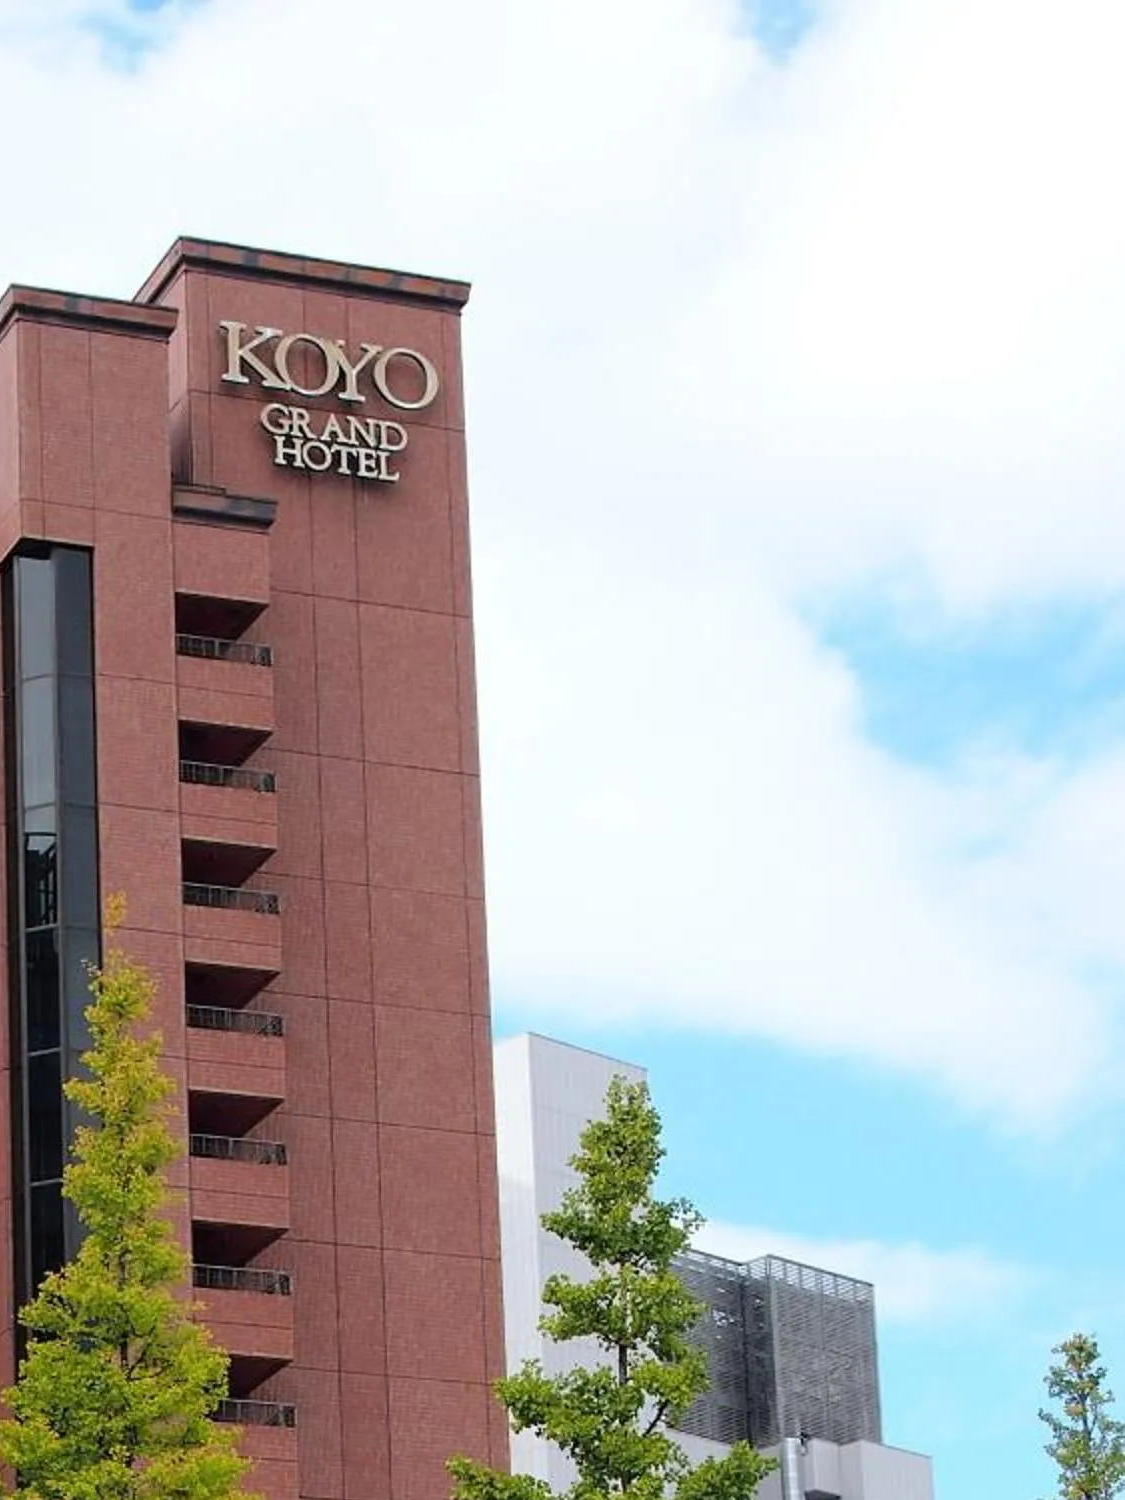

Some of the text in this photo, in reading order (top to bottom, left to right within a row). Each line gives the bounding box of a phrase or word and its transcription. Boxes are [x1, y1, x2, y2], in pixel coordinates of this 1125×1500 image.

[219, 320, 440, 410] KOYO
[259, 402, 409, 452] GRAND
[273, 435, 401, 482] HOTEL
